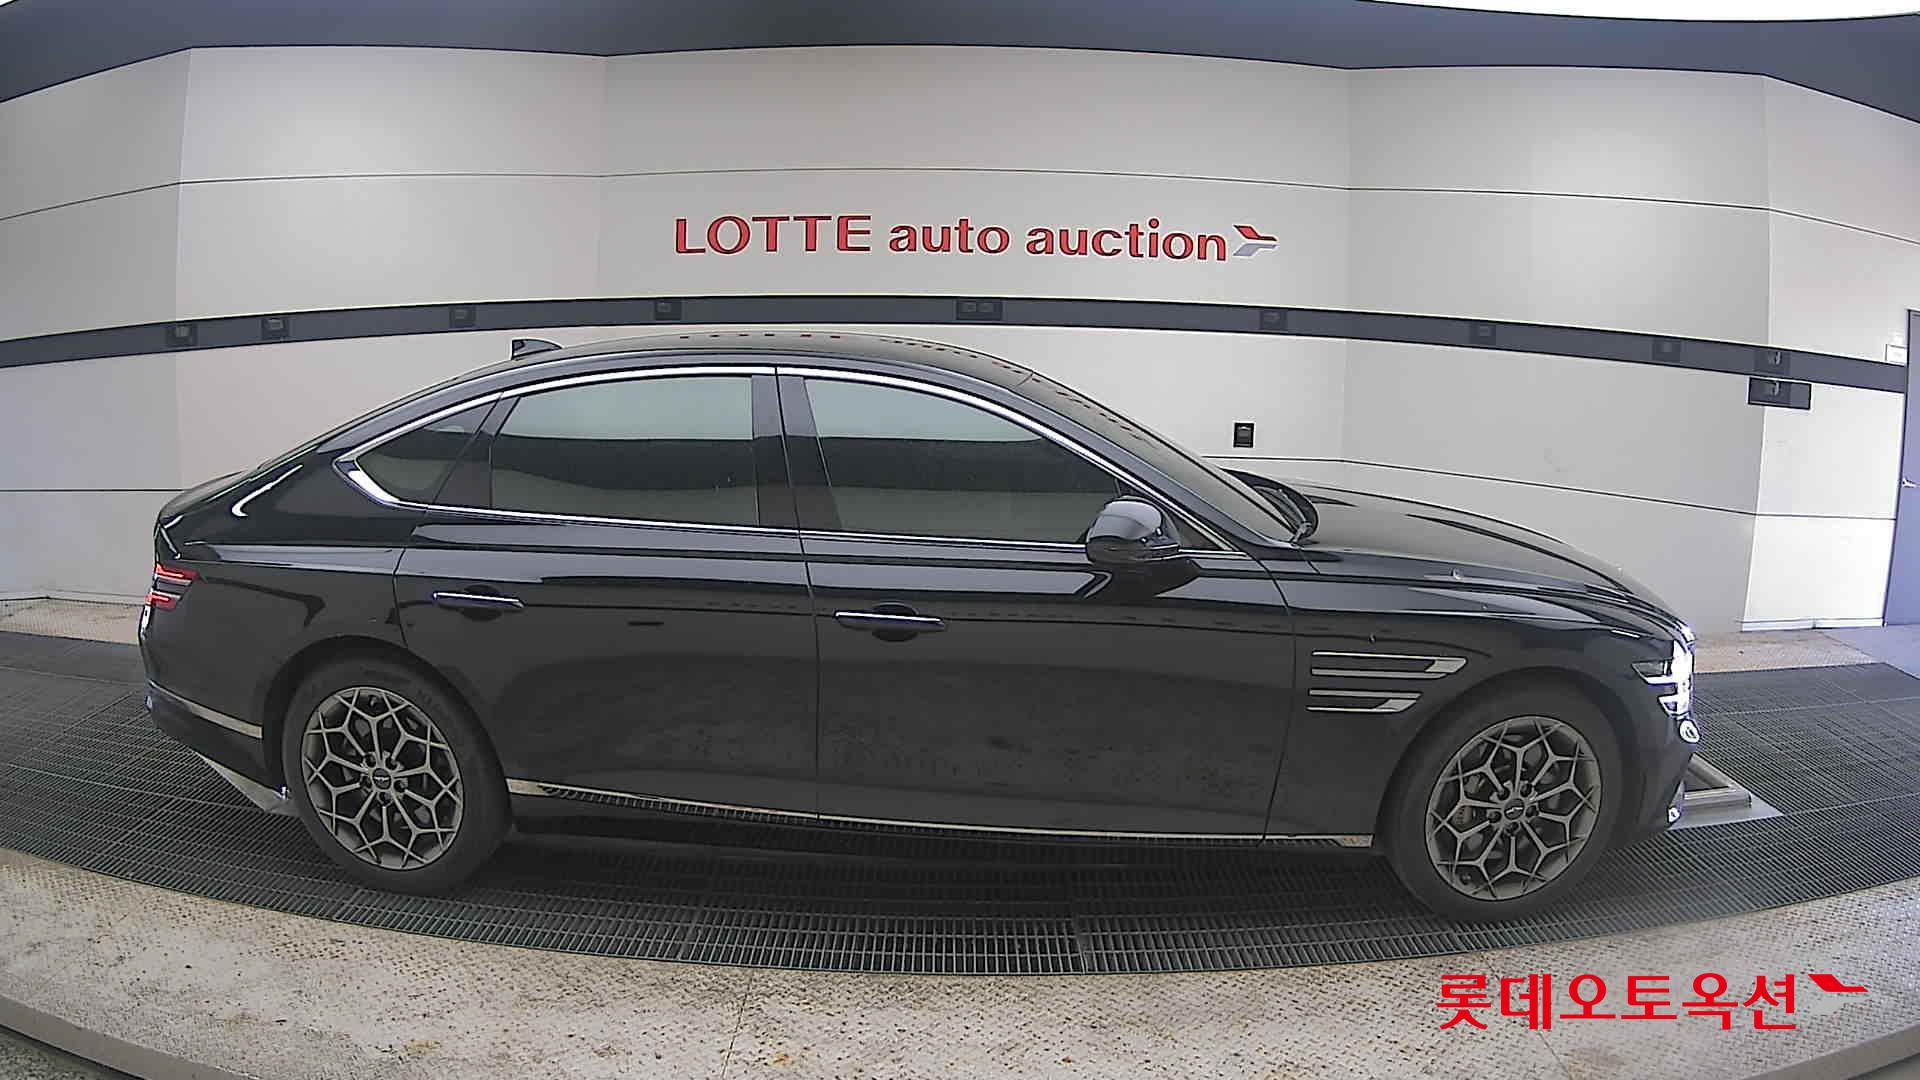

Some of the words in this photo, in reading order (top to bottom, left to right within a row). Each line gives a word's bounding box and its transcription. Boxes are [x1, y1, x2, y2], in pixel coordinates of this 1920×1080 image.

[674, 216, 871, 254] LOTTE
[889, 218, 1011, 254] auto
[1026, 219, 1228, 262] auction
